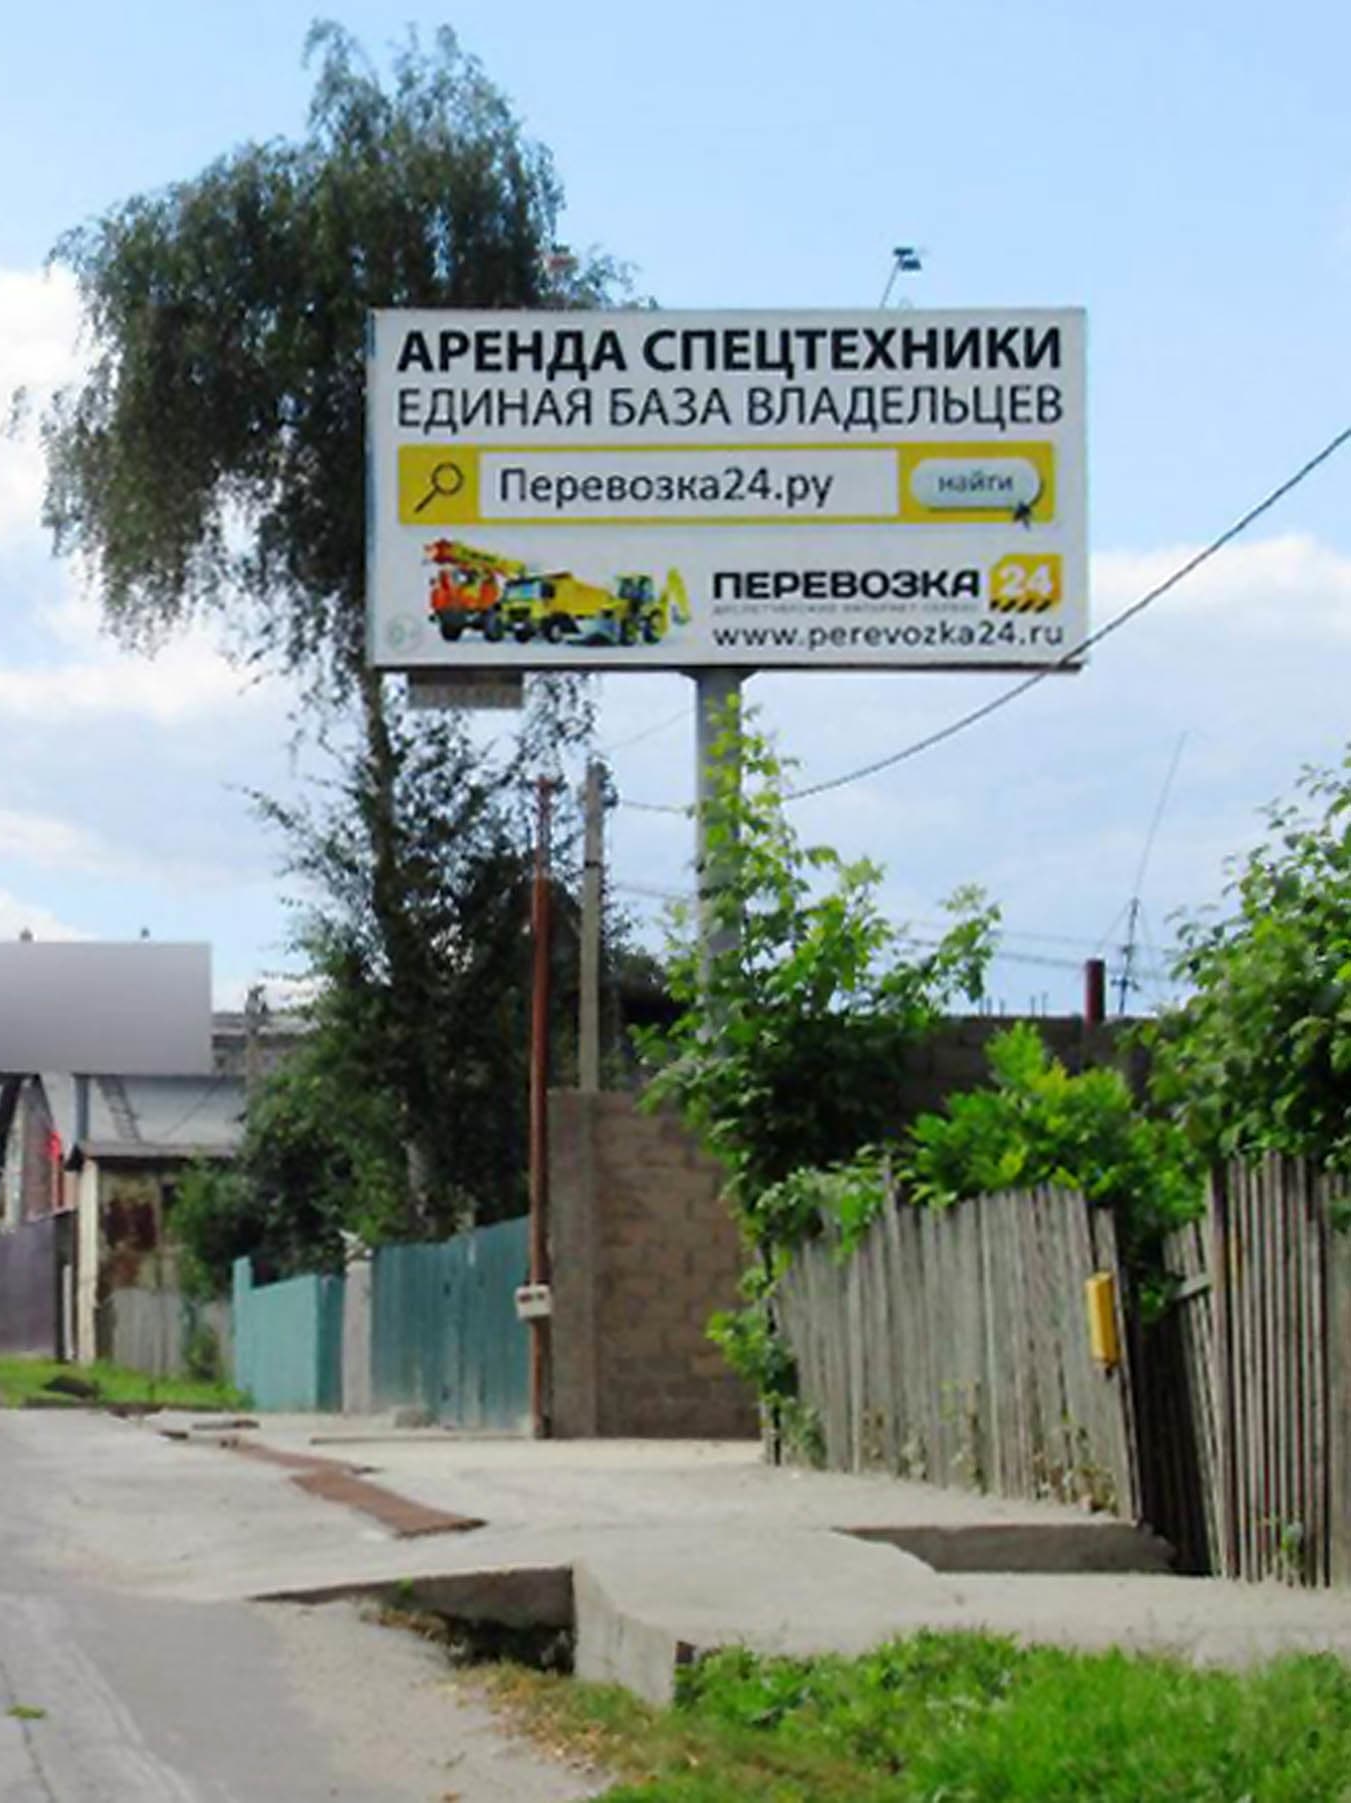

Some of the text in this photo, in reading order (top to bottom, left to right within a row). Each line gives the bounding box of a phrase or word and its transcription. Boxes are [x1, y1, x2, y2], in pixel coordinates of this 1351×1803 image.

[397, 327, 1061, 381] АРЕНДА СПЕЦТЕХНИКИ
[398, 384, 1064, 435] ЕДИНАЯ БАЗА ВЛАДЕЛЬЦЕВ
[500, 467, 834, 509] Перевозка24.ру
[938, 470, 1014, 493] найти
[713, 564, 1053, 600] ПЕРЕВОЗКА 24
[713, 620, 1064, 648] www.perevozka24.ru
